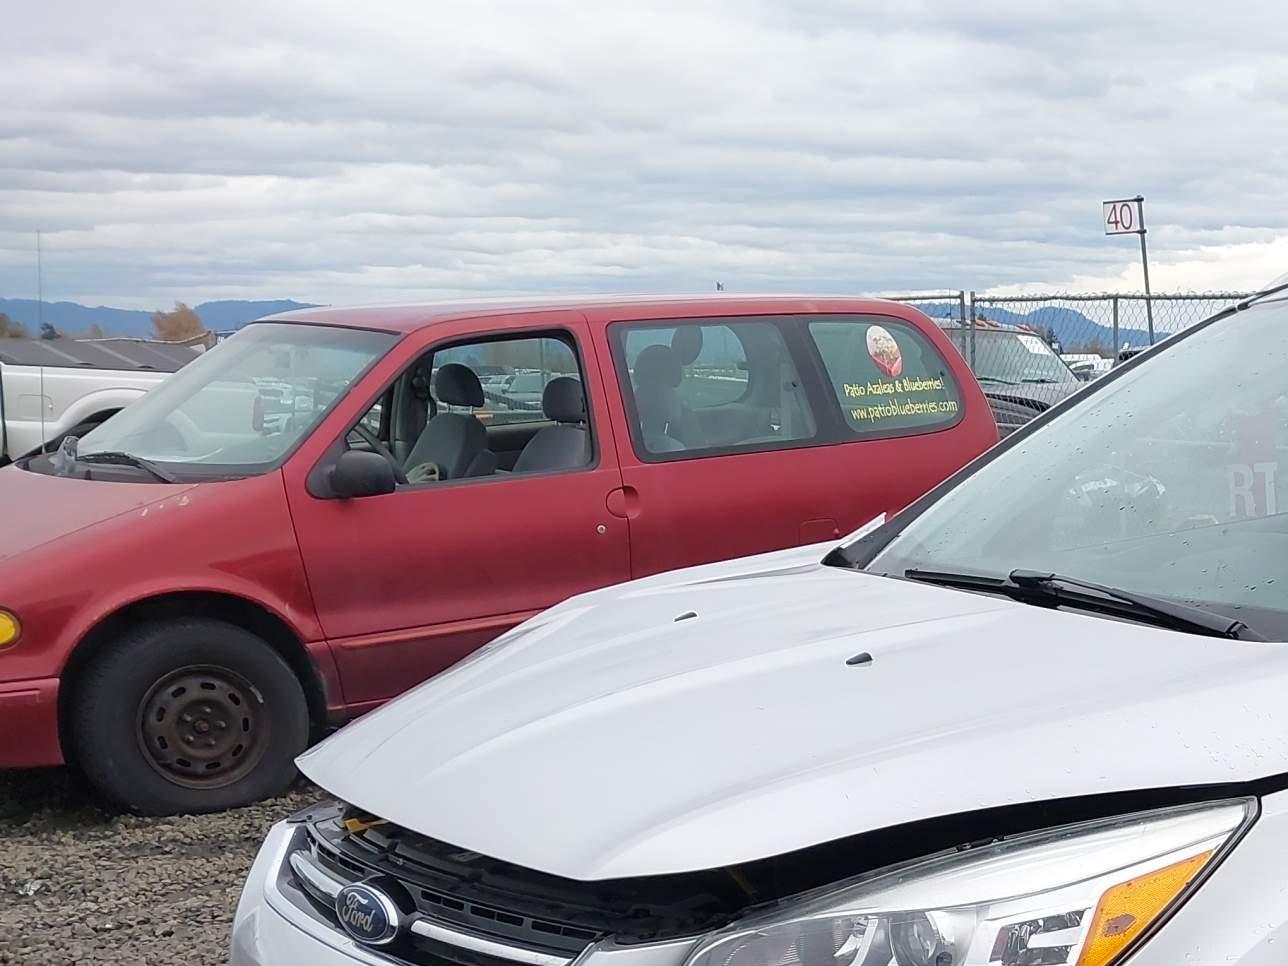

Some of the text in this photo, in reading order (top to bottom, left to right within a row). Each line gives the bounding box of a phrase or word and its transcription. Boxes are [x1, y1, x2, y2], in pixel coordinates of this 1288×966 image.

[1107, 203, 1133, 230] 40
[843, 375, 945, 398] Patio Azaleas & Blueberries!
[341, 891, 376, 933] Ford
